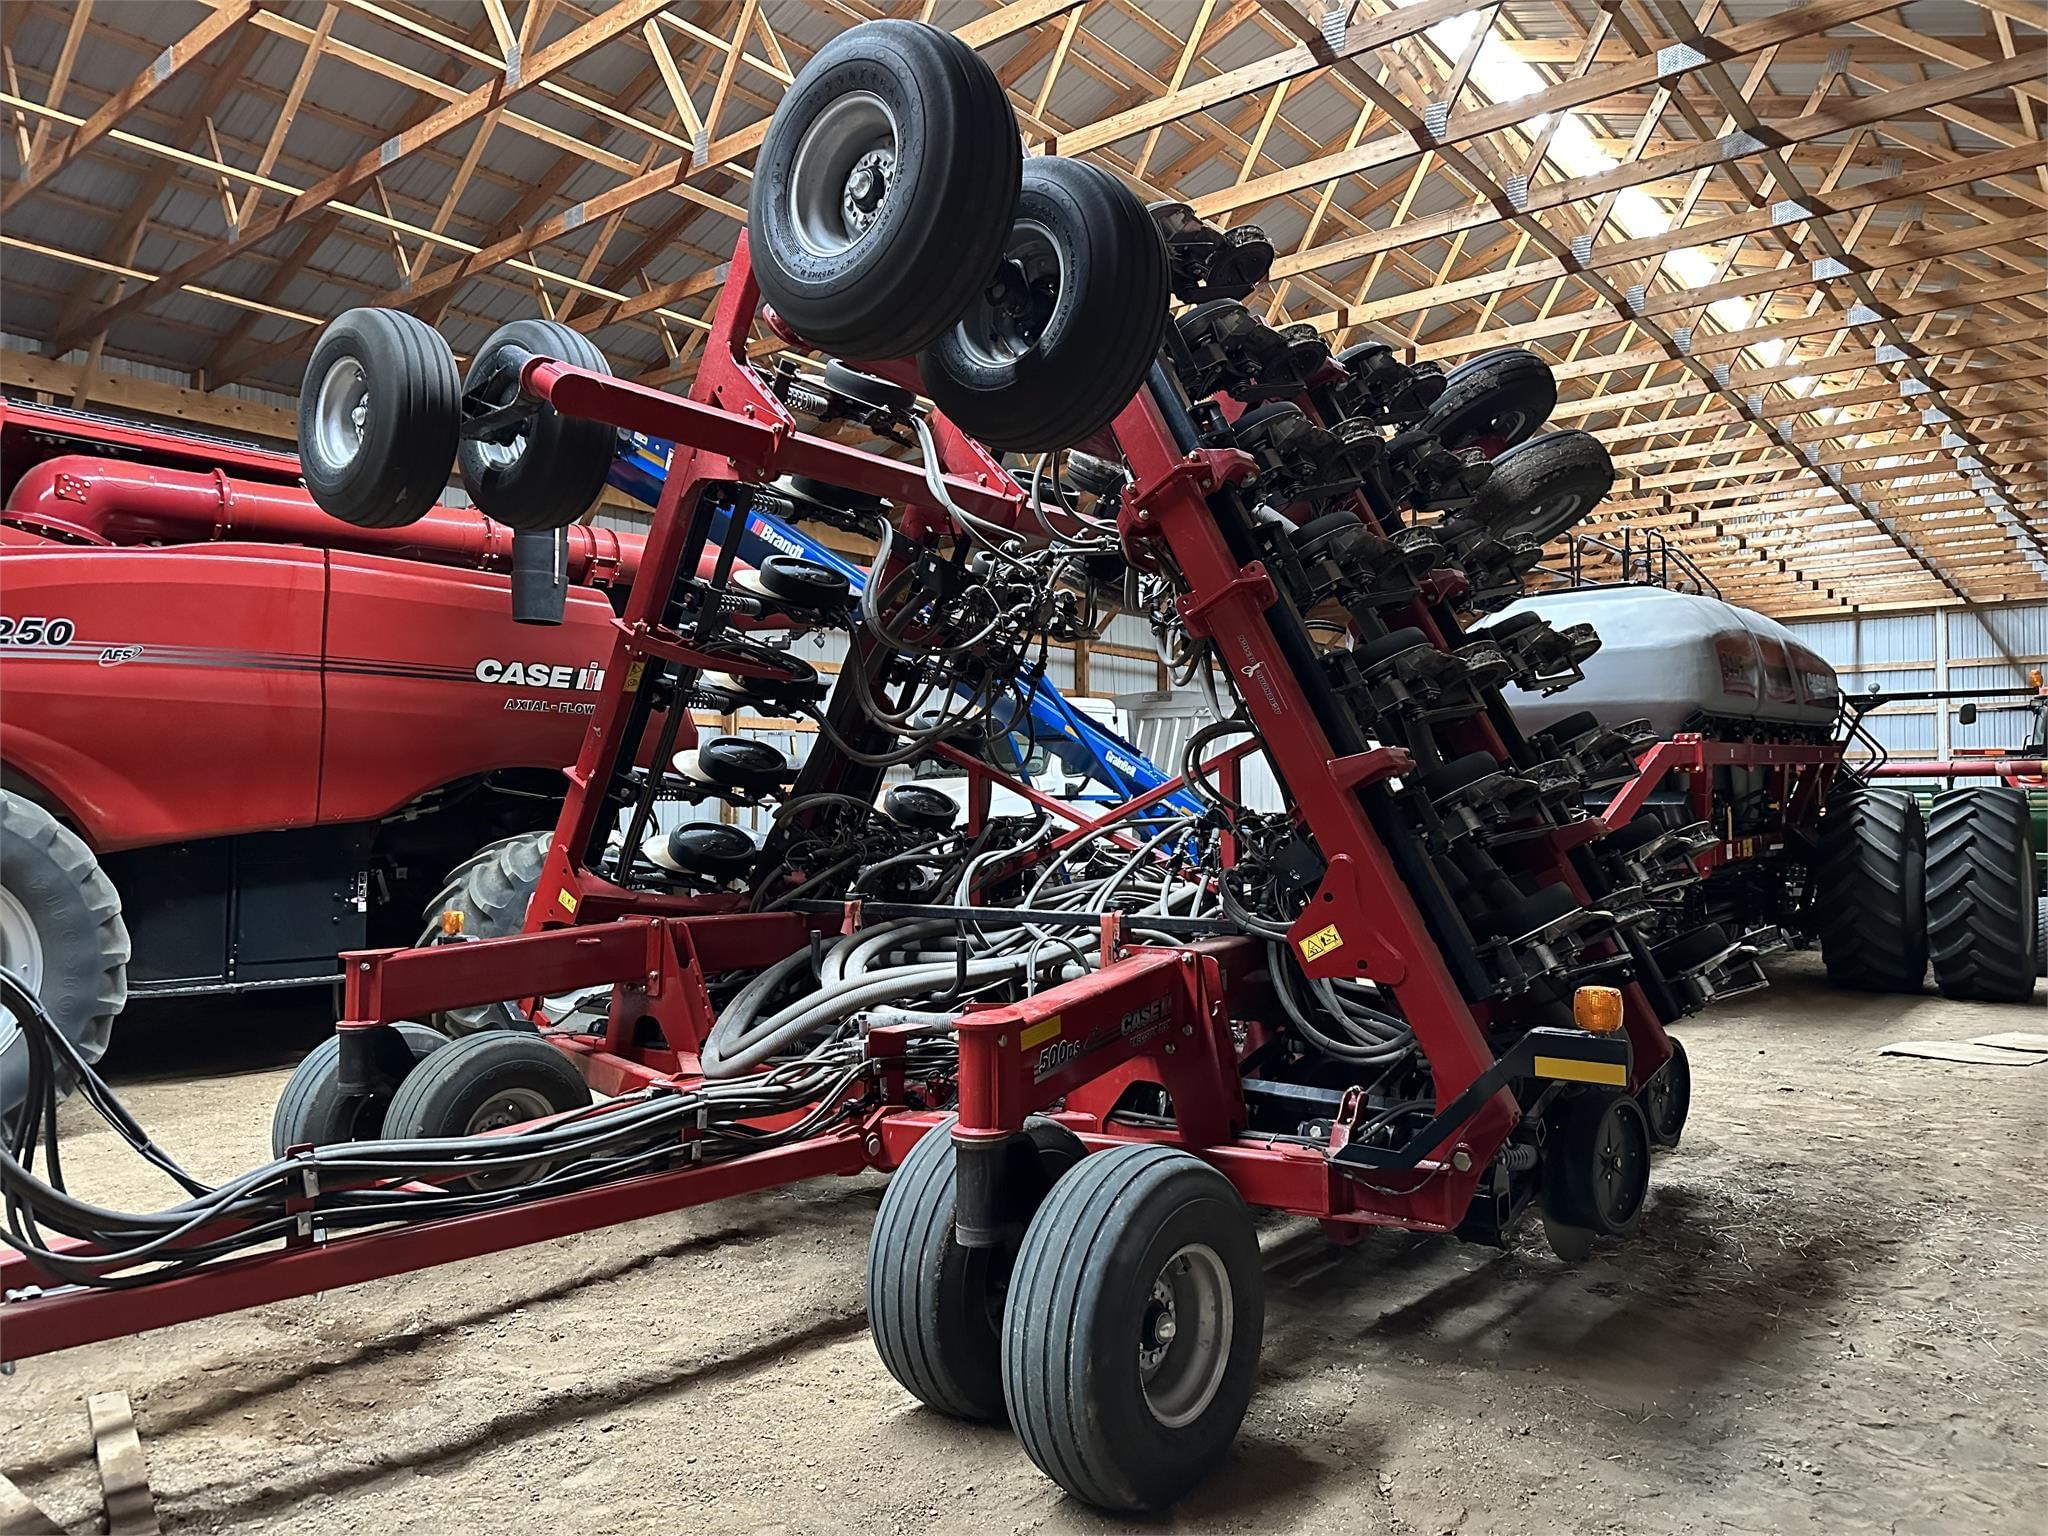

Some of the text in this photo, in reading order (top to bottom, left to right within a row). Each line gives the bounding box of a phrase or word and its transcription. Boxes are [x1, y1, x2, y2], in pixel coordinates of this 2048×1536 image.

[760, 523, 805, 559] Brandt
[100, 648, 133, 661] AFS
[475, 659, 574, 689] CASE
